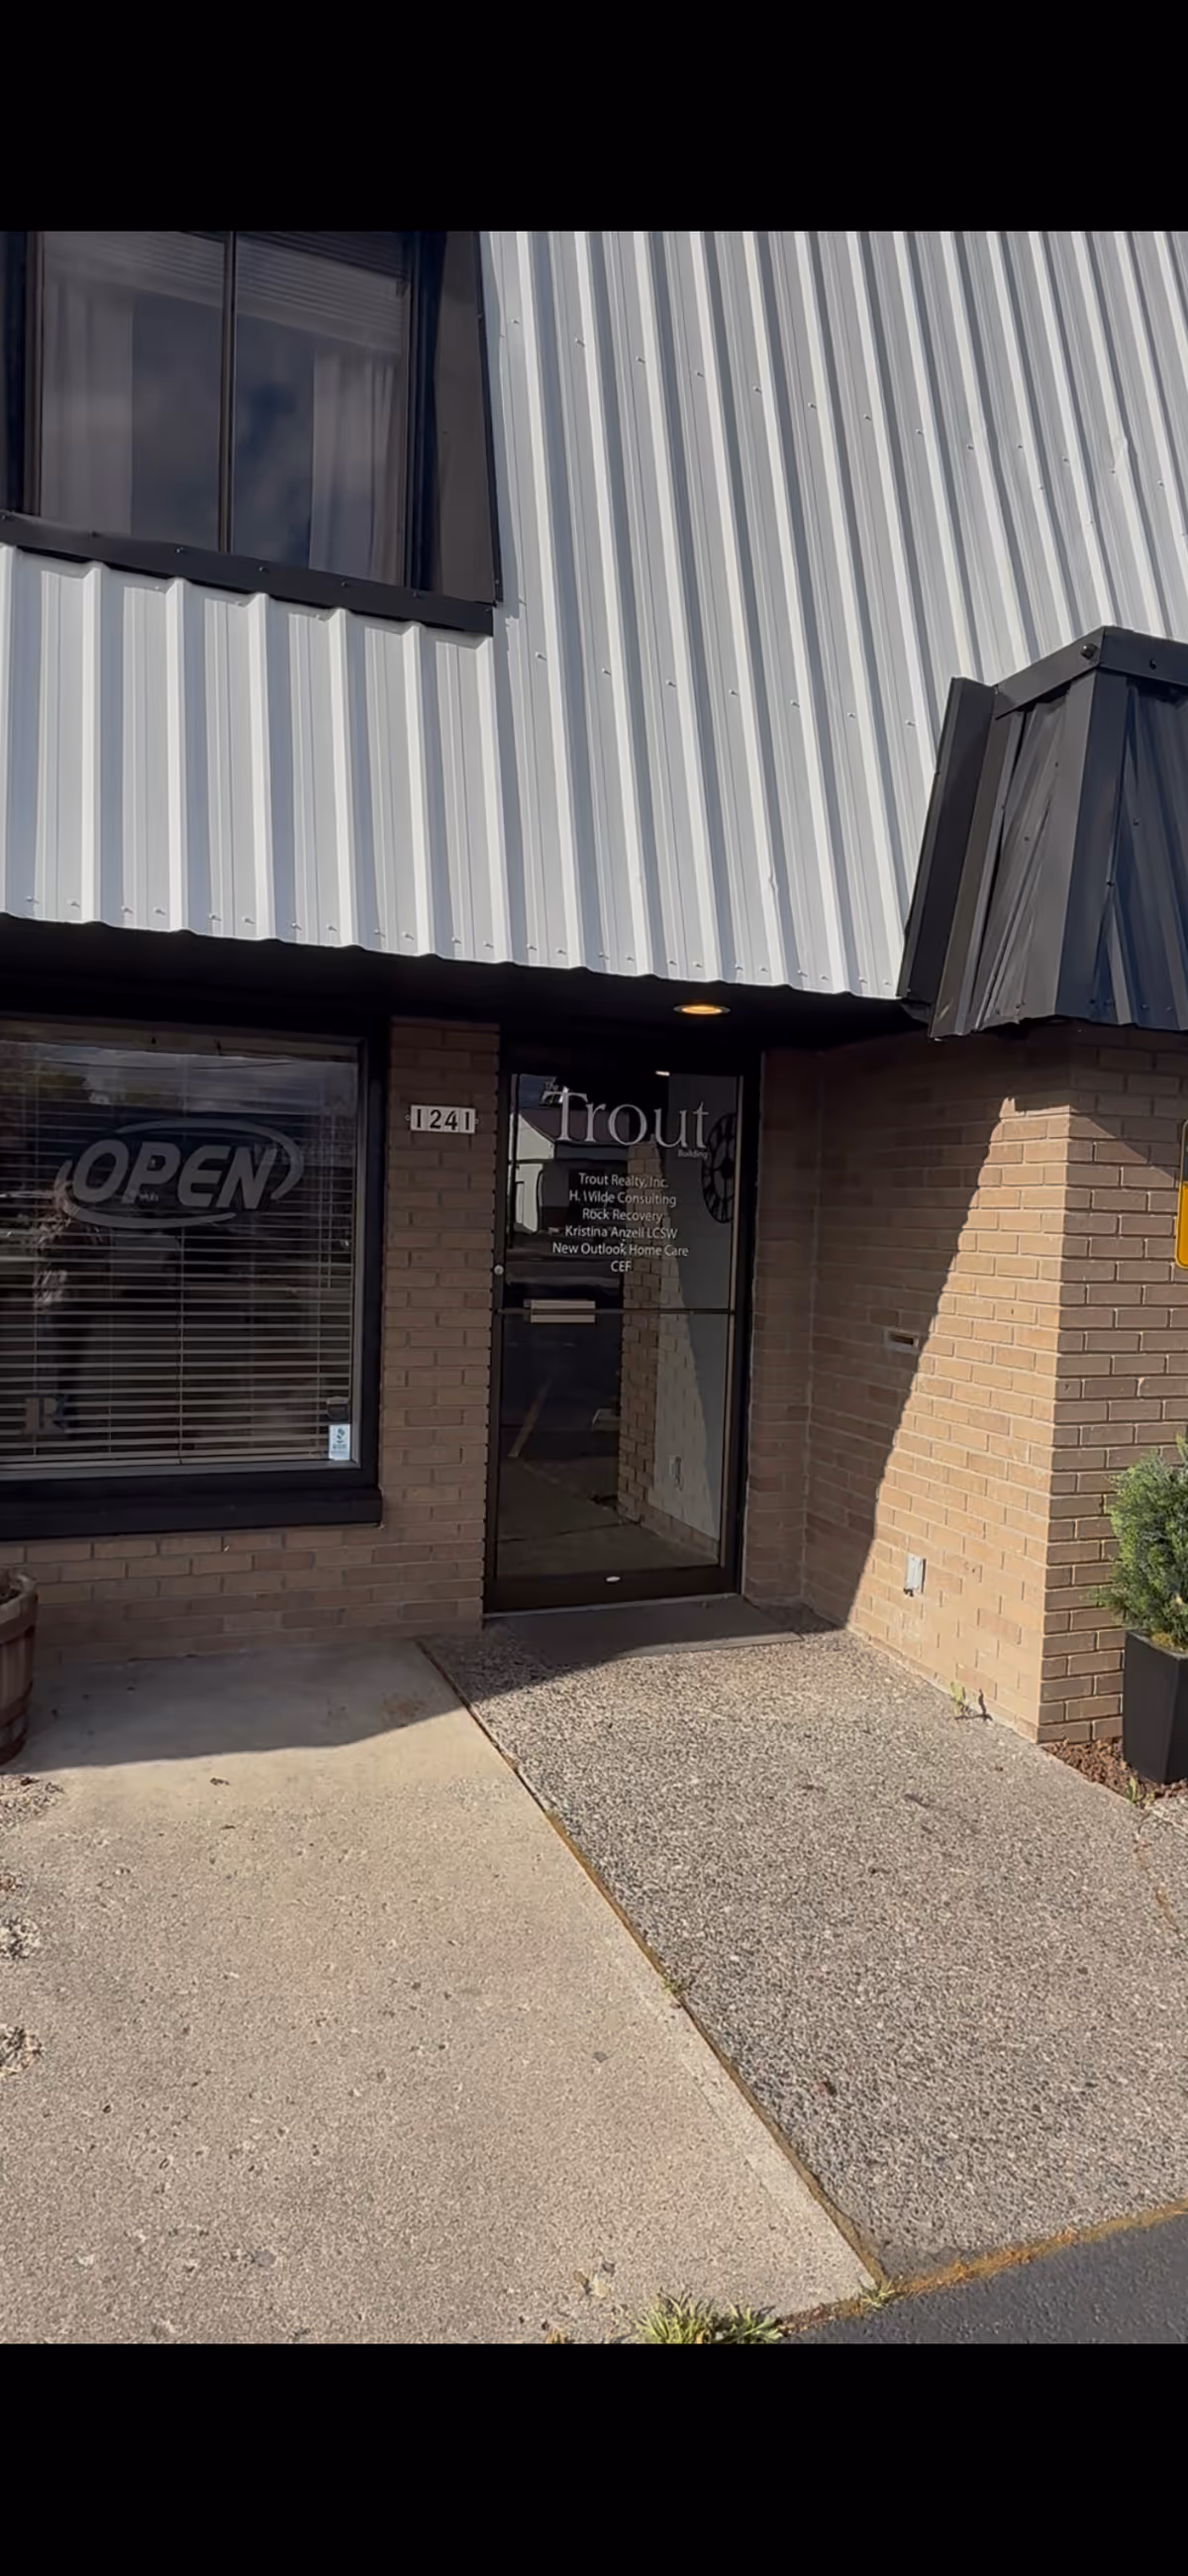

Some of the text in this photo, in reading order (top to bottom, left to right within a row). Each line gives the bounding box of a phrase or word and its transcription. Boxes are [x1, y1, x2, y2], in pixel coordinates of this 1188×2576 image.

[417, 1109, 470, 1130] 1241
[542, 1090, 709, 1149] Trout
[678, 1149, 708, 1159] Building
[72, 1139, 277, 1209] OPEN
[579, 1173, 668, 1188] Trout Realty, Inc.
[569, 1190, 581, 1201] H.
[618, 1192, 677, 1207] Consulting
[582, 1208, 663, 1223] Rock Recovery
[565, 1225, 678, 1239] Kristina Anzell LCSW
[552, 1242, 689, 1256] New Outlook Home Care
[611, 1261, 632, 1273] CEF
